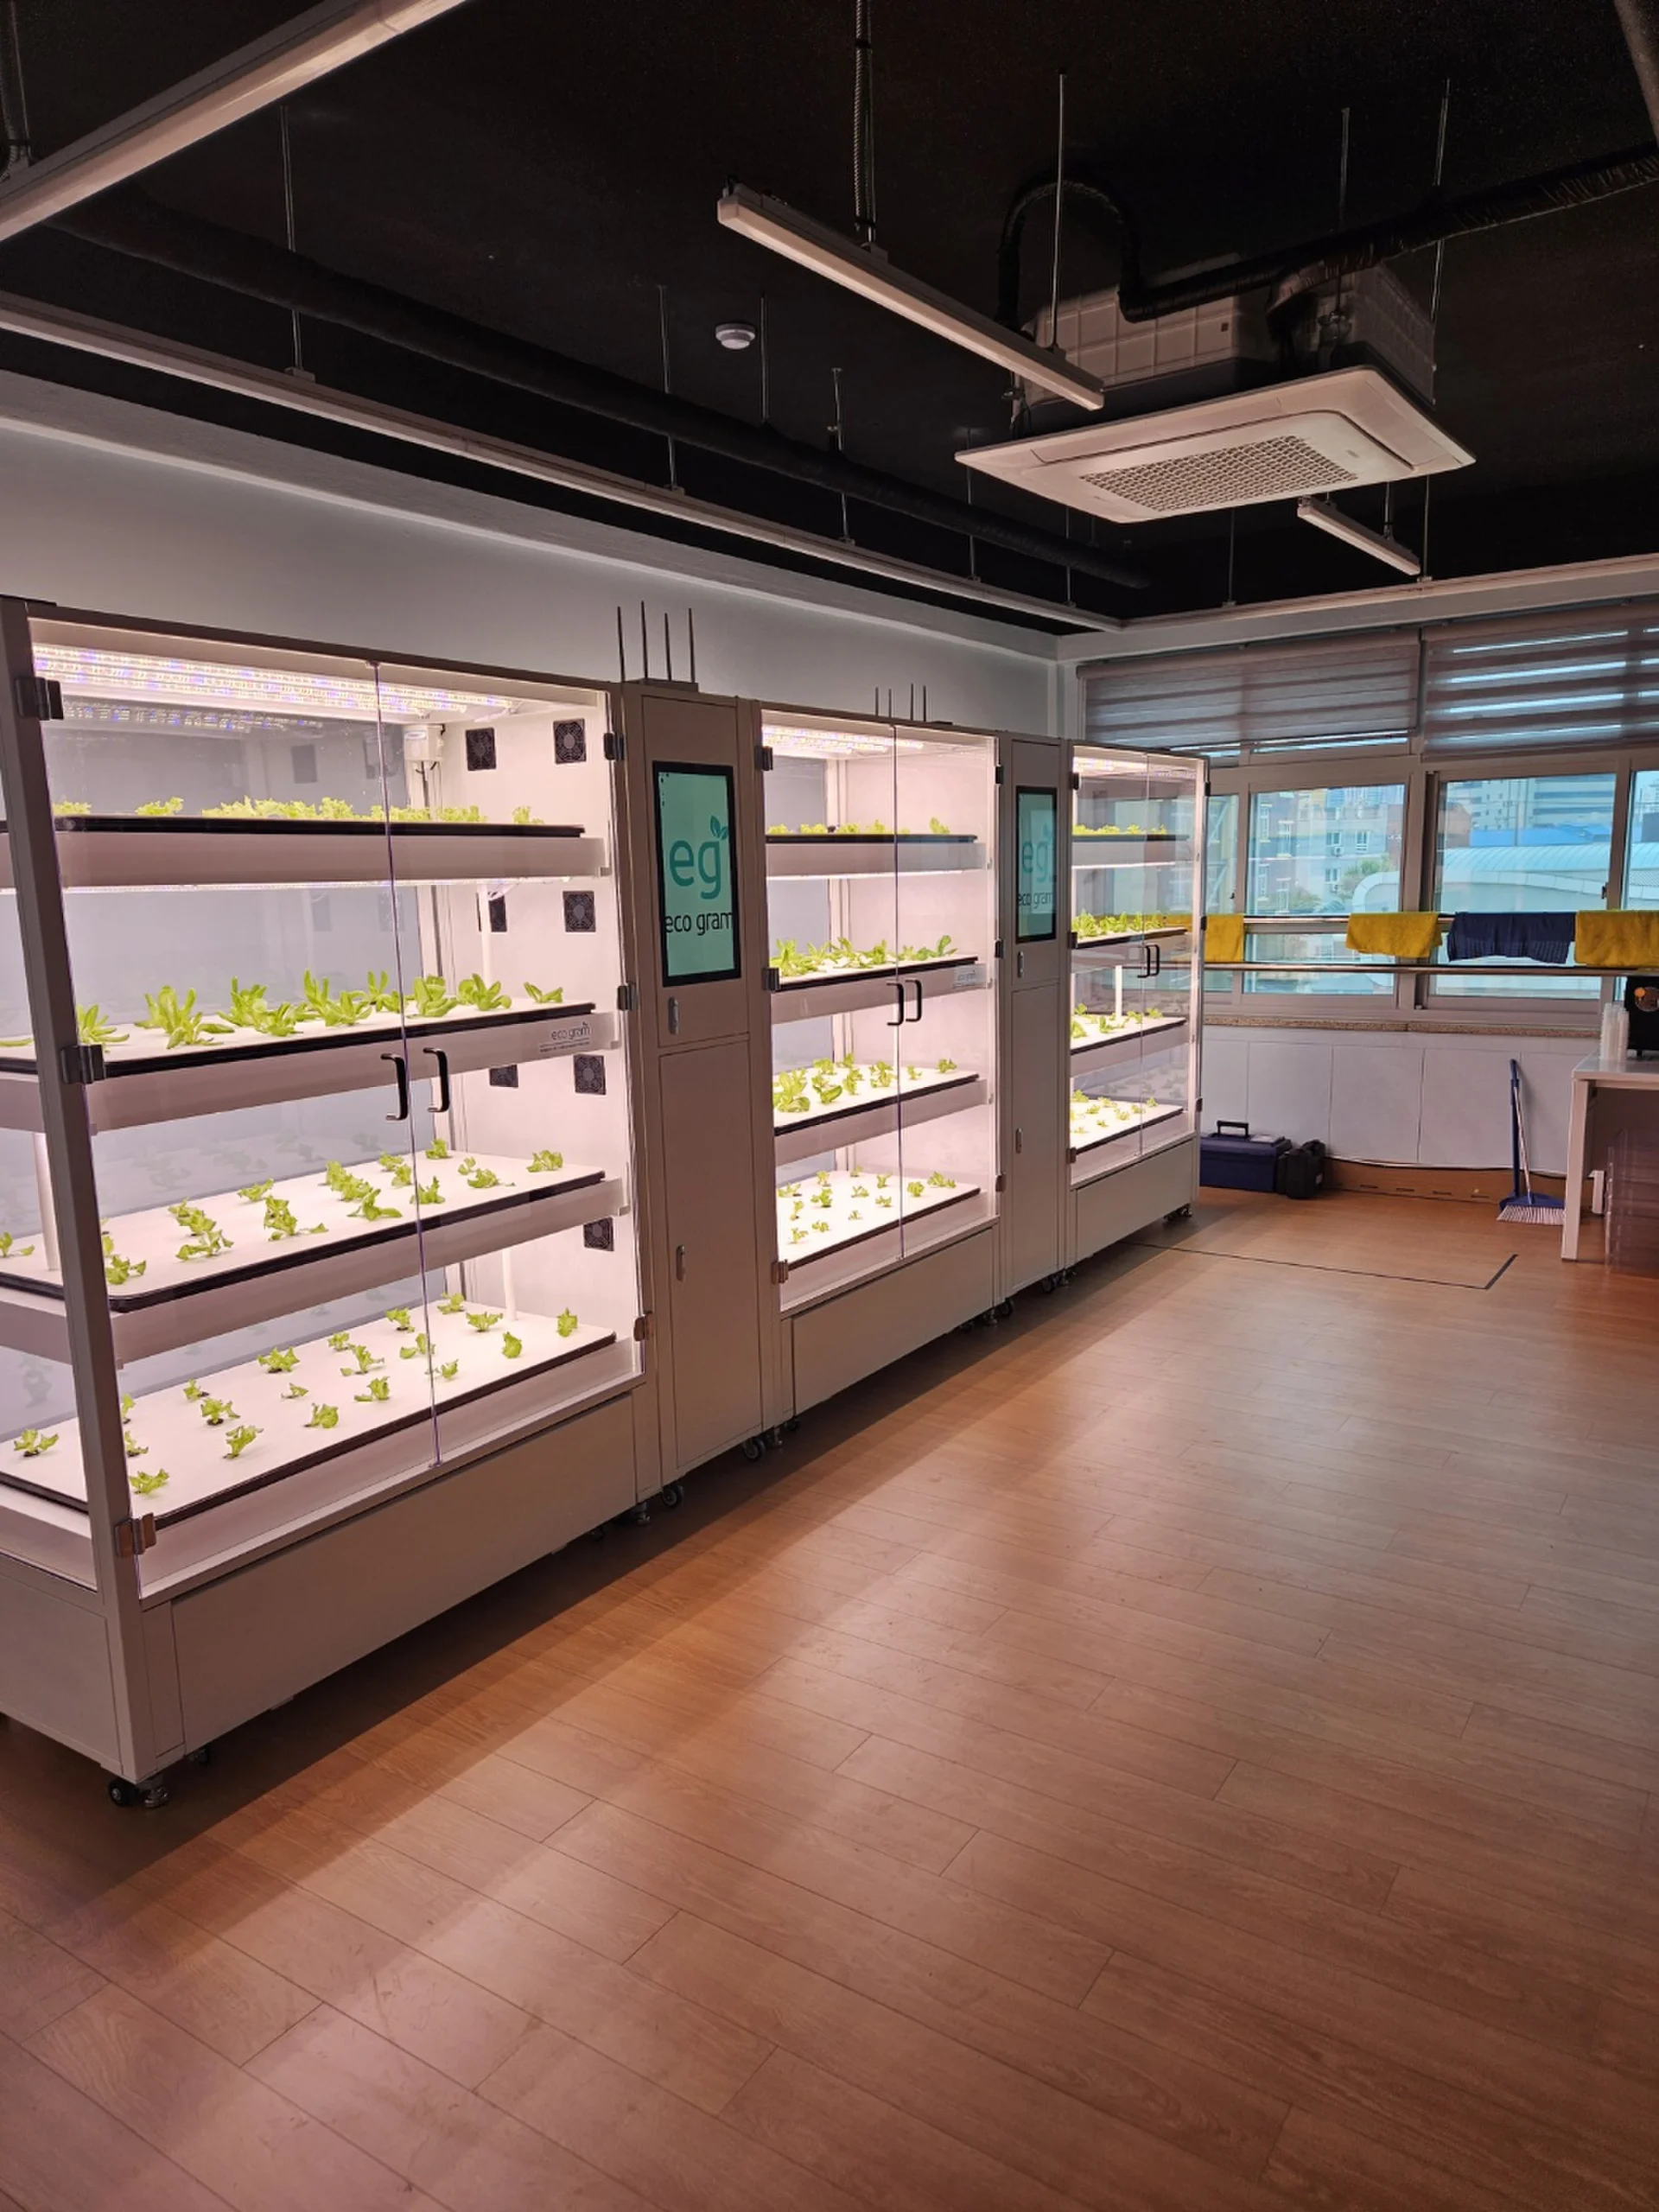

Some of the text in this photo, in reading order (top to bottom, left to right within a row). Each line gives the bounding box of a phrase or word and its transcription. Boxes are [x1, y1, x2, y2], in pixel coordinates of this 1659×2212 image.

[670, 840, 721, 899] eg
[1022, 841, 1048, 882] eg
[664, 915, 691, 933] eco
[551, 1030, 568, 1040] eco
